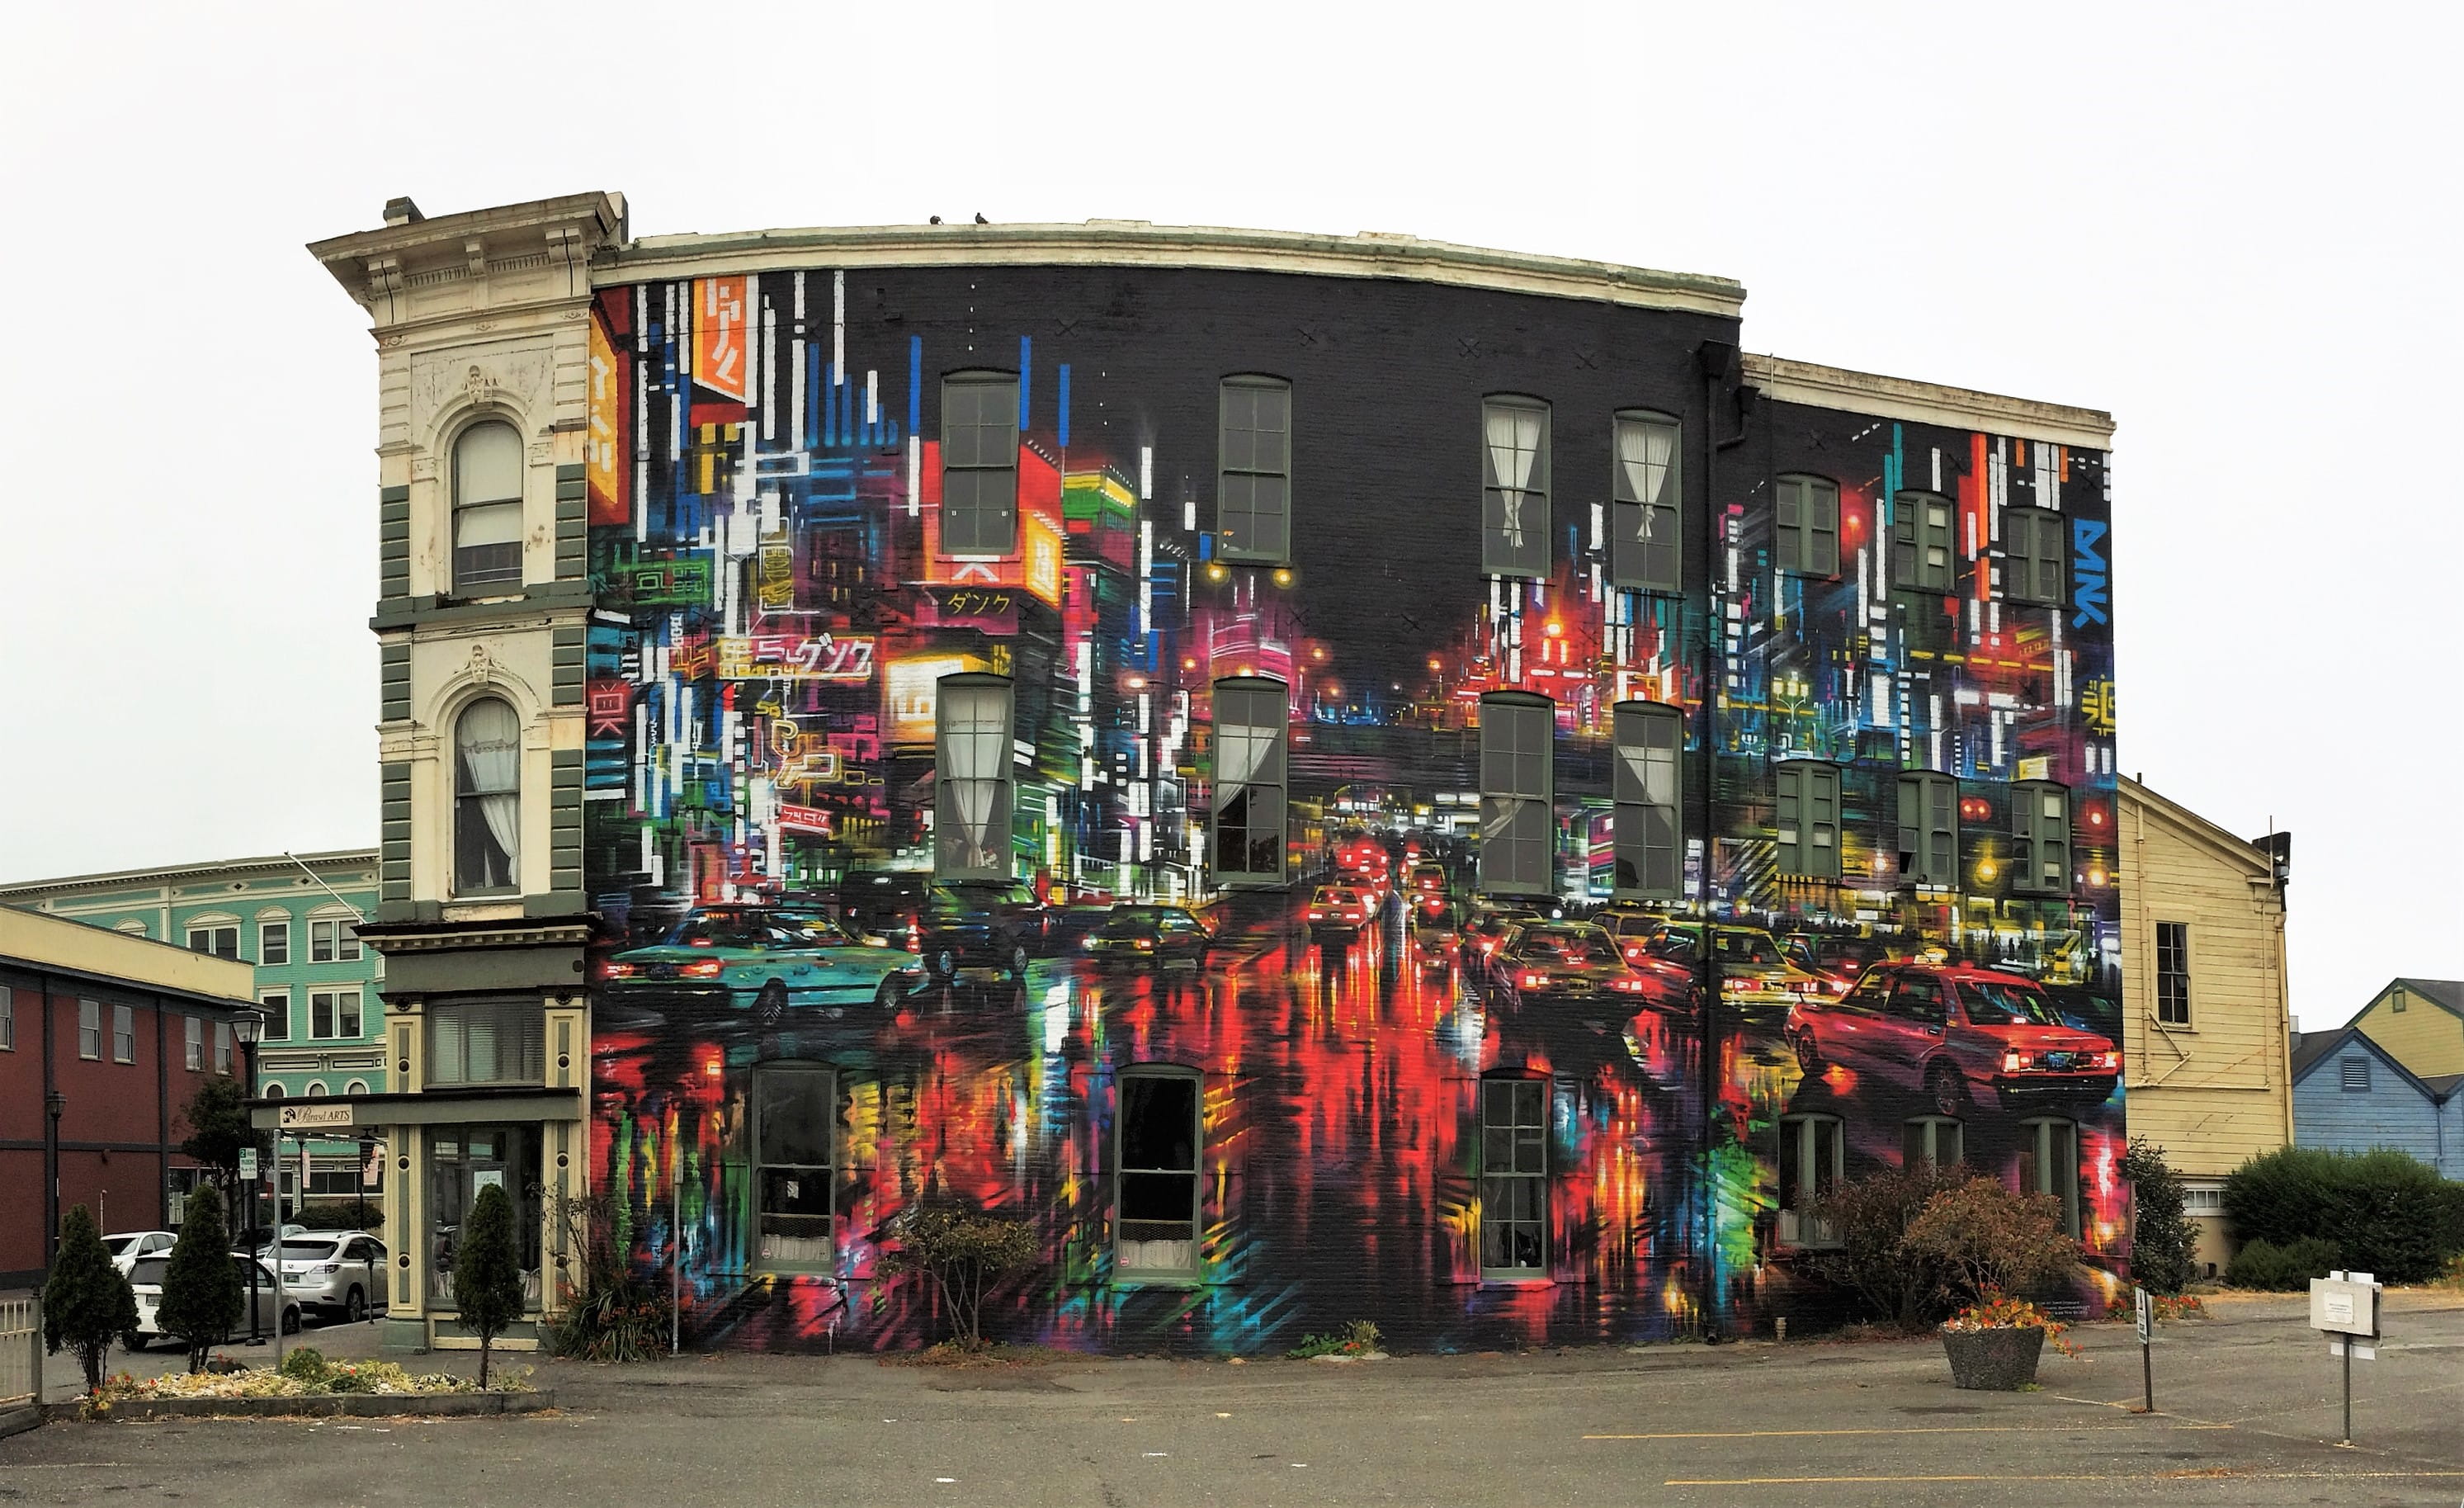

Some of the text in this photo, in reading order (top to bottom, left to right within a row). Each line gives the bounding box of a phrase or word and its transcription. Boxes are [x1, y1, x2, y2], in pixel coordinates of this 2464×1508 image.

[947, 592, 1010, 615] ダンク
[328, 1110, 350, 1120] ARTS
